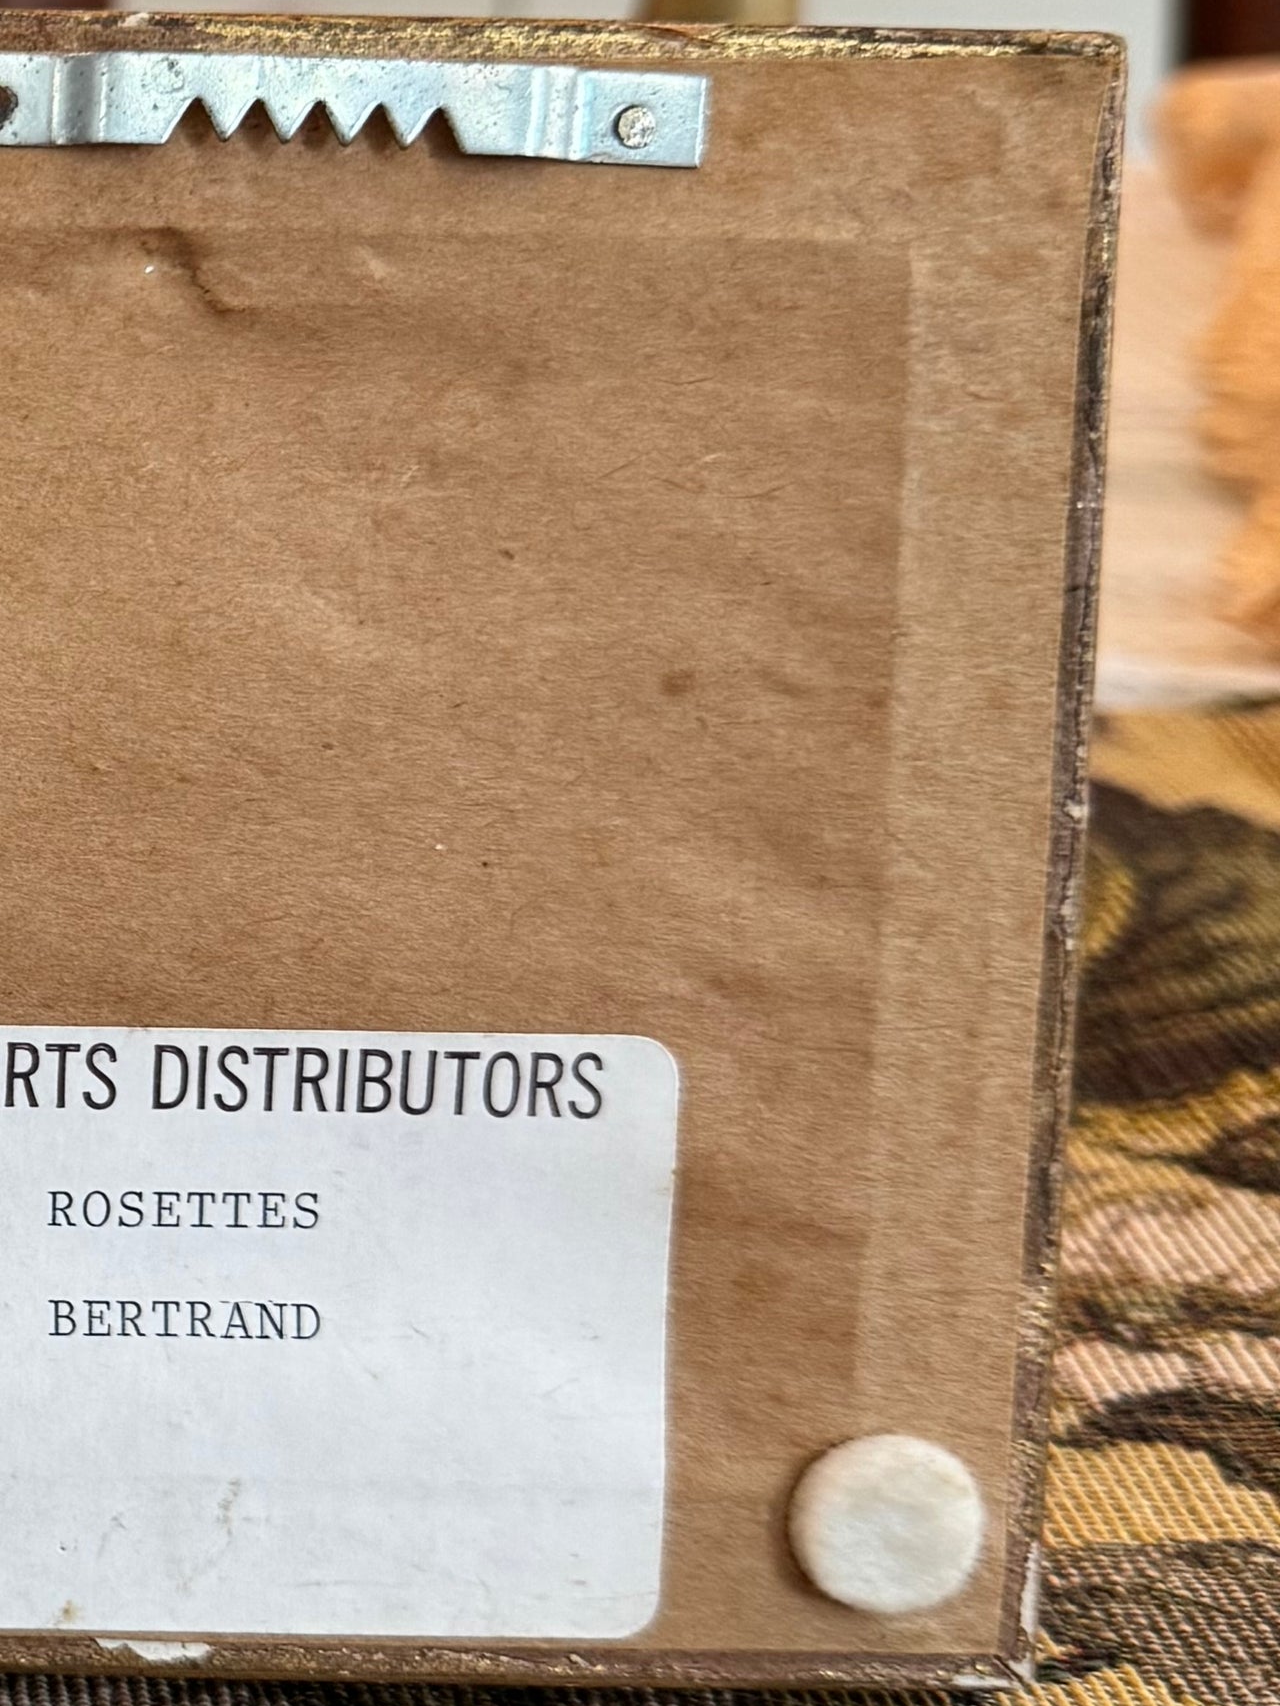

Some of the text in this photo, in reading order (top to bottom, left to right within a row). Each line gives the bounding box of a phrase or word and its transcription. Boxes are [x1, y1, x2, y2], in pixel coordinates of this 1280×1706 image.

[152, 1045, 602, 1119] DISTRIBUTORS
[47, 1190, 319, 1229] ROSETTES
[48, 1300, 320, 1339] BERTRAND
